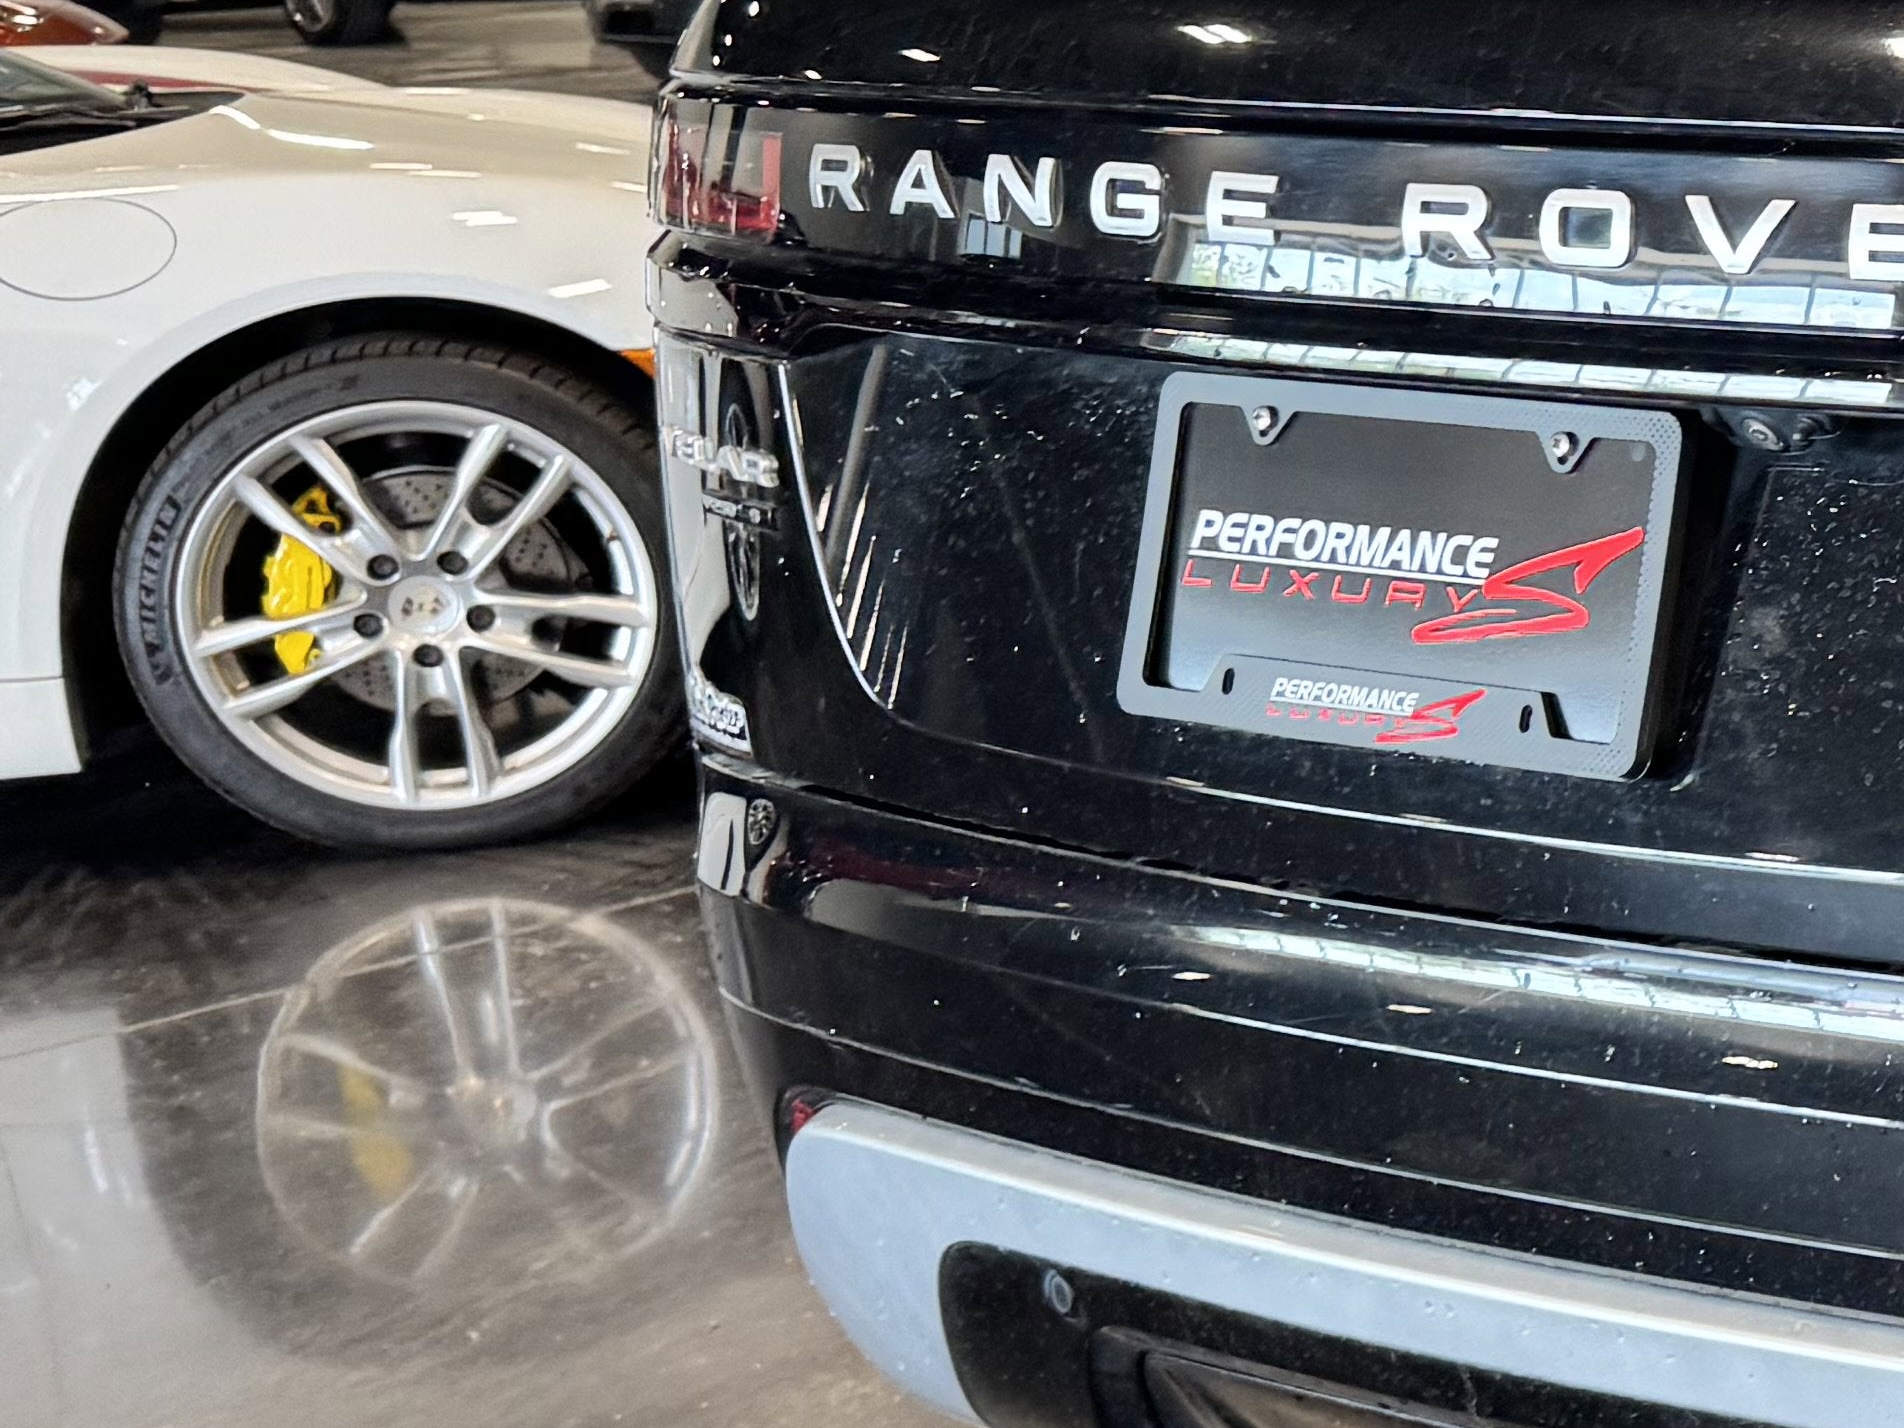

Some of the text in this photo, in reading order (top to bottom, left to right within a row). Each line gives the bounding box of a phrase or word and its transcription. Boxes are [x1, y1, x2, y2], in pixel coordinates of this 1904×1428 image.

[808, 142, 1280, 245] RANGE
[1190, 508, 1500, 580] PERFORMANCE
[1181, 558, 1478, 614] LUXURY
[1270, 676, 1420, 712] PERFORMANCE
